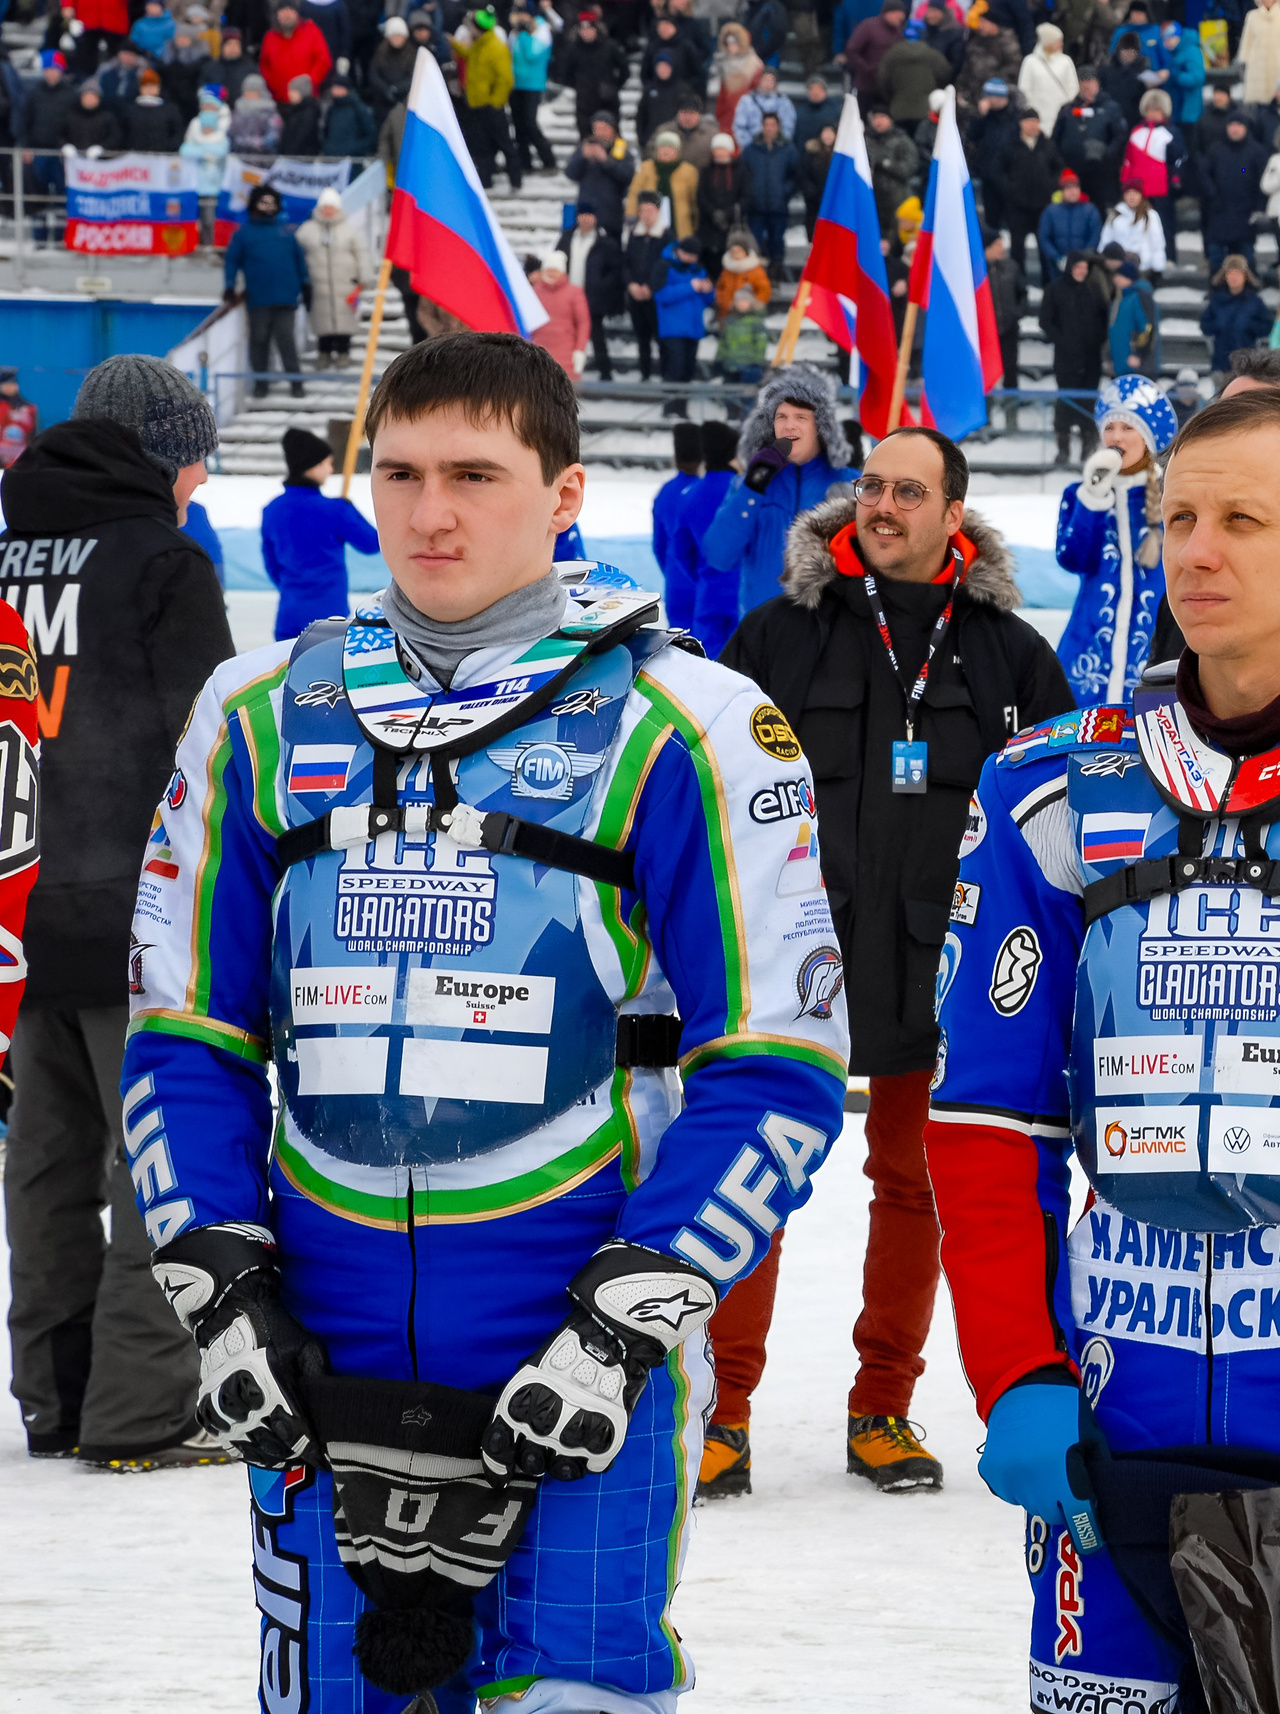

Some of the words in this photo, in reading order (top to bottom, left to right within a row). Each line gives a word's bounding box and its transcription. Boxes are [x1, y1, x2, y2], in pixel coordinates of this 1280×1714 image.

[74, 223, 153, 250] РОССИЯ
[0, 539, 98, 578] REW
[494, 677, 532, 697] 114
[1155, 708, 1203, 782] УРАЛГАЗ
[524, 757, 564, 782] FIM
[753, 784, 801, 821] elf
[342, 877, 490, 893] SPEEDWAY
[435, 976, 530, 1005] Europe
[466, 1000, 496, 1010] Suisse
[1130, 1126, 1187, 1140] УГМК
[1130, 1140, 1187, 1154] UMMC
[122, 1072, 196, 1250] UFA
[670, 1110, 828, 1284] UFA
[1072, 1512, 1098, 1550] RUSSIA
[1056, 1531, 1081, 1659] УРА
[1036, 1690, 1052, 1705] BY
